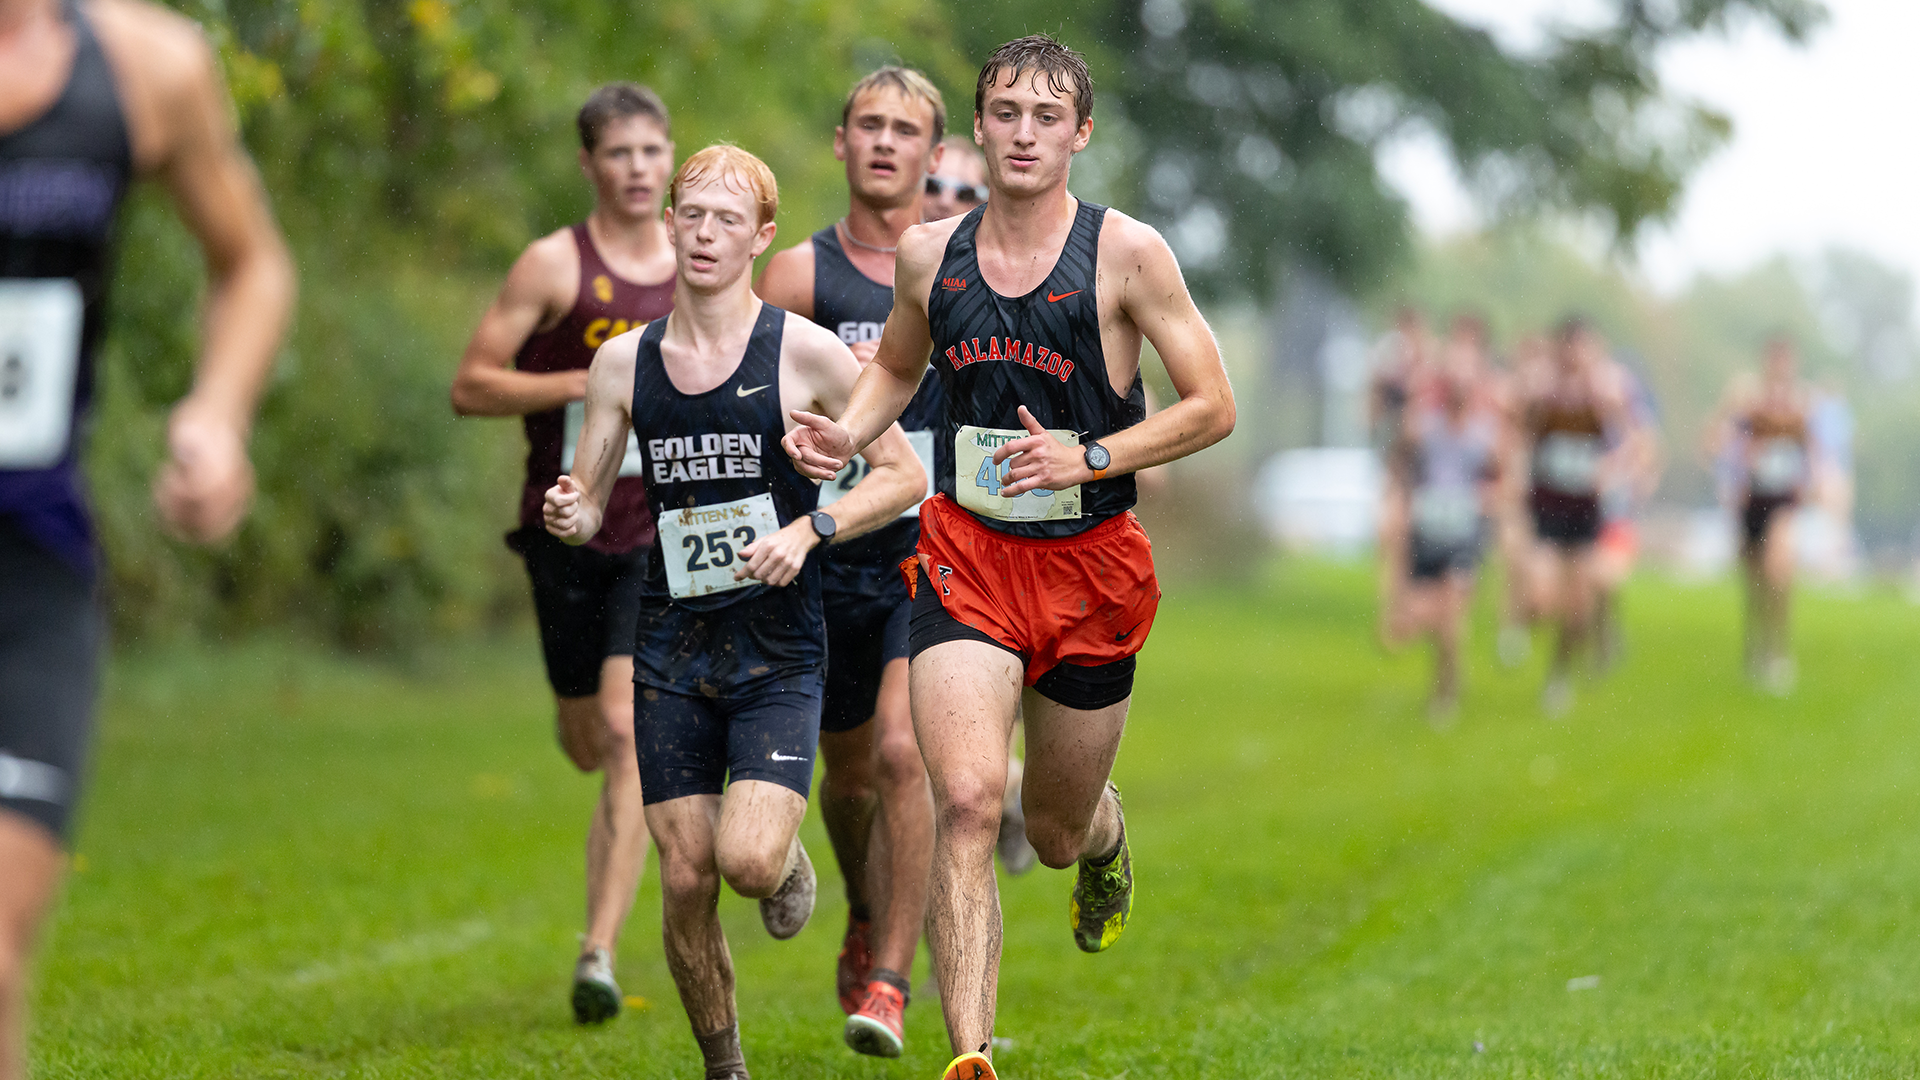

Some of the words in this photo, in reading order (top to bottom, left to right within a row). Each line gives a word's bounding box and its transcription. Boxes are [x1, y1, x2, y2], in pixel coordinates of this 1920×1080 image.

[942, 277, 966, 288] MIAA
[837, 321, 886, 344] GO
[945, 336, 1075, 382] KALAMAZOO
[648, 433, 762, 461] GOLDEN
[652, 456, 762, 484] EAGLES
[678, 508, 729, 527] MITTEN
[730, 503, 751, 519] XC
[682, 525, 757, 573] 253
